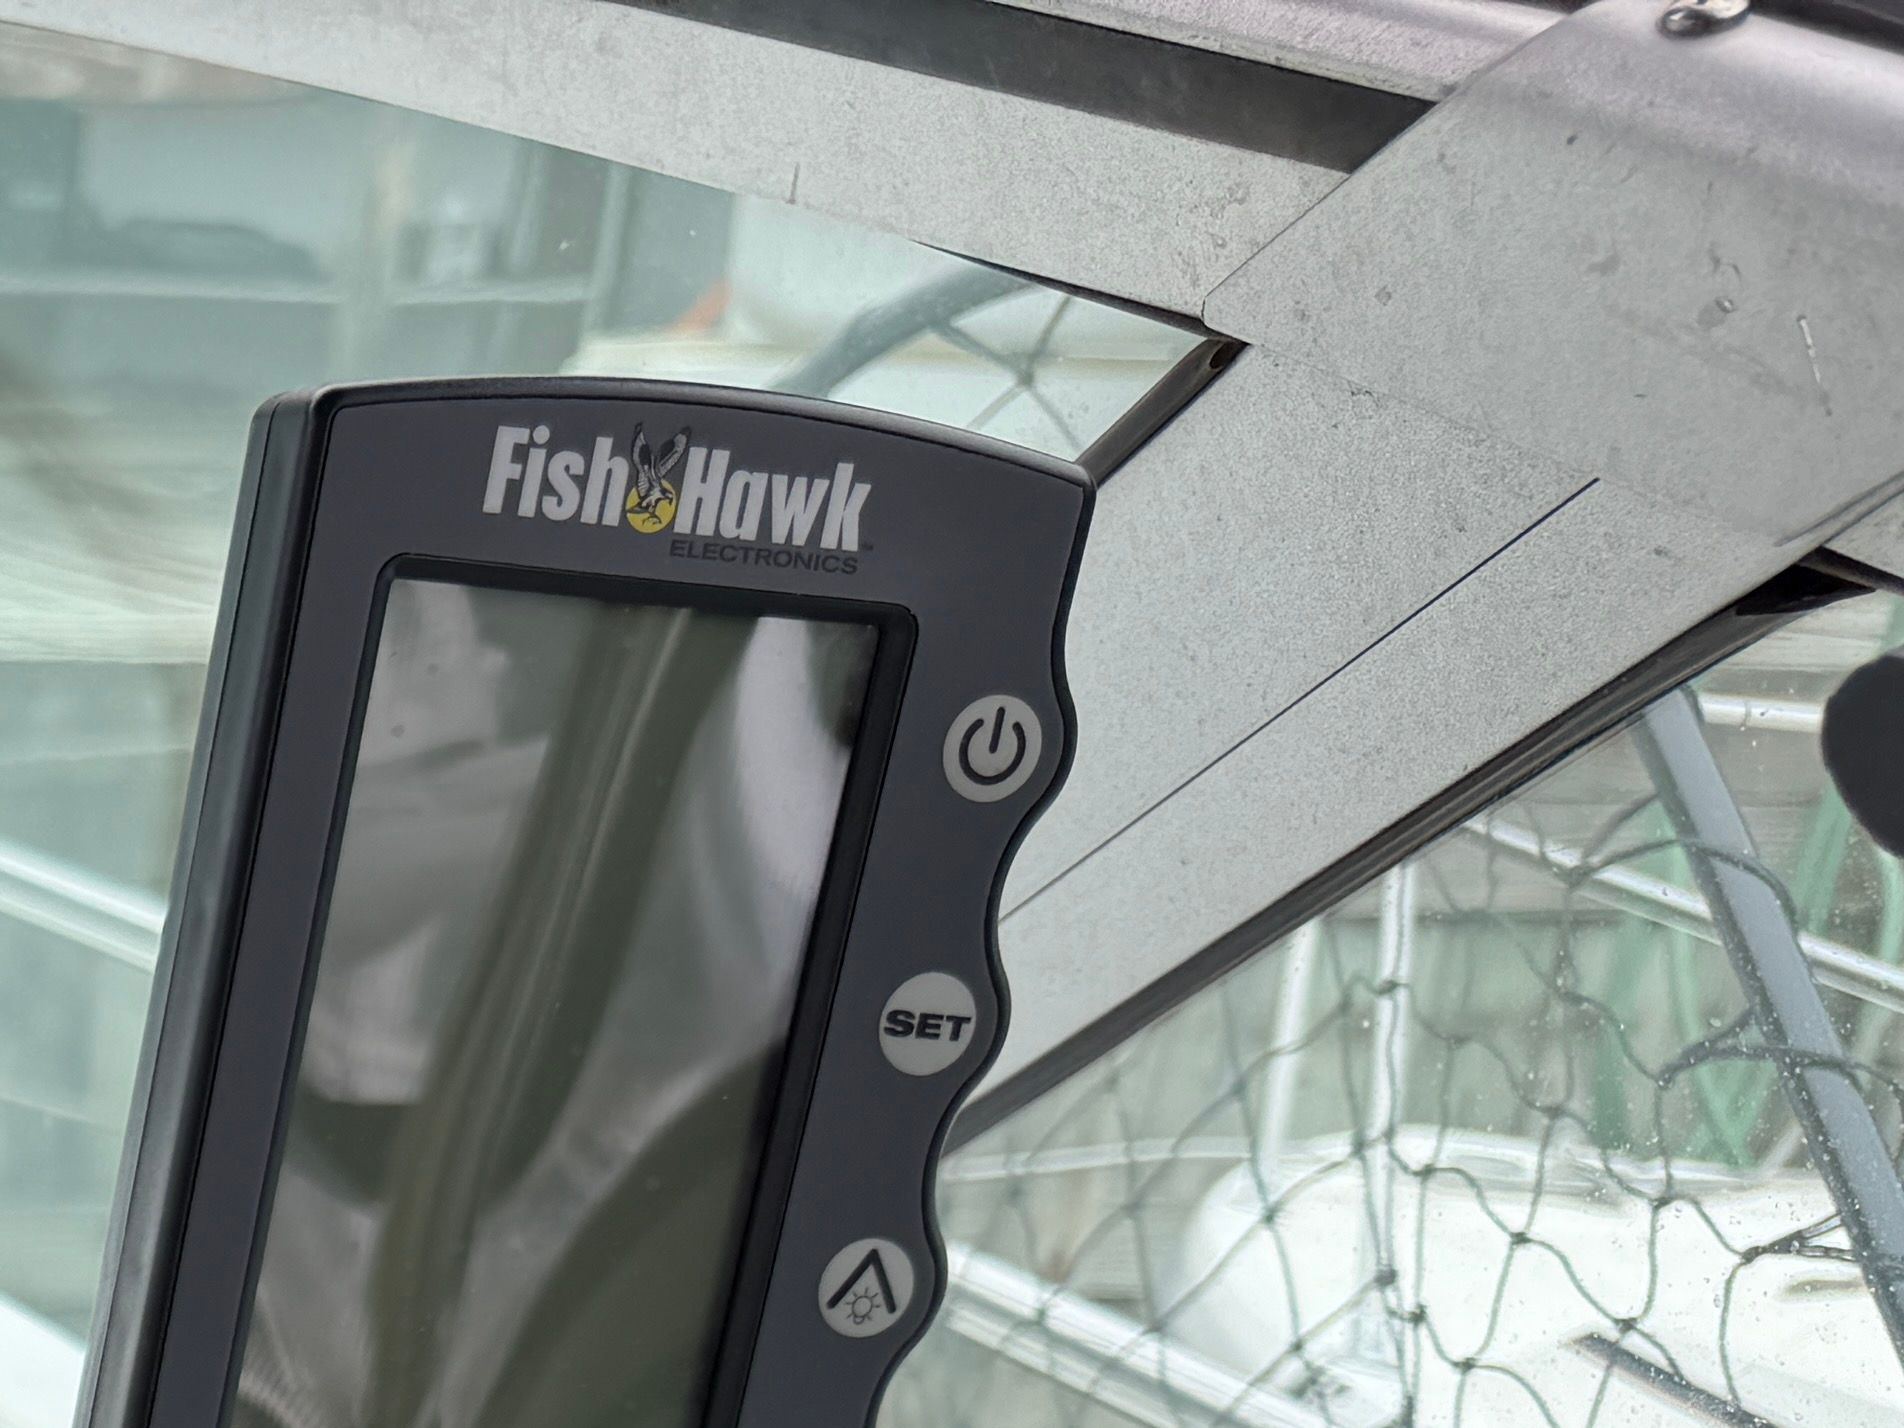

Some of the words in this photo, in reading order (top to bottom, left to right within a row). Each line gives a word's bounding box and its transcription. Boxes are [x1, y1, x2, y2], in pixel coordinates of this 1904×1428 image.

[482, 424, 630, 527] Fish
[673, 445, 872, 553] Hawk
[668, 539, 860, 575] ELECTRONICS
[883, 1009, 972, 1042] SET
